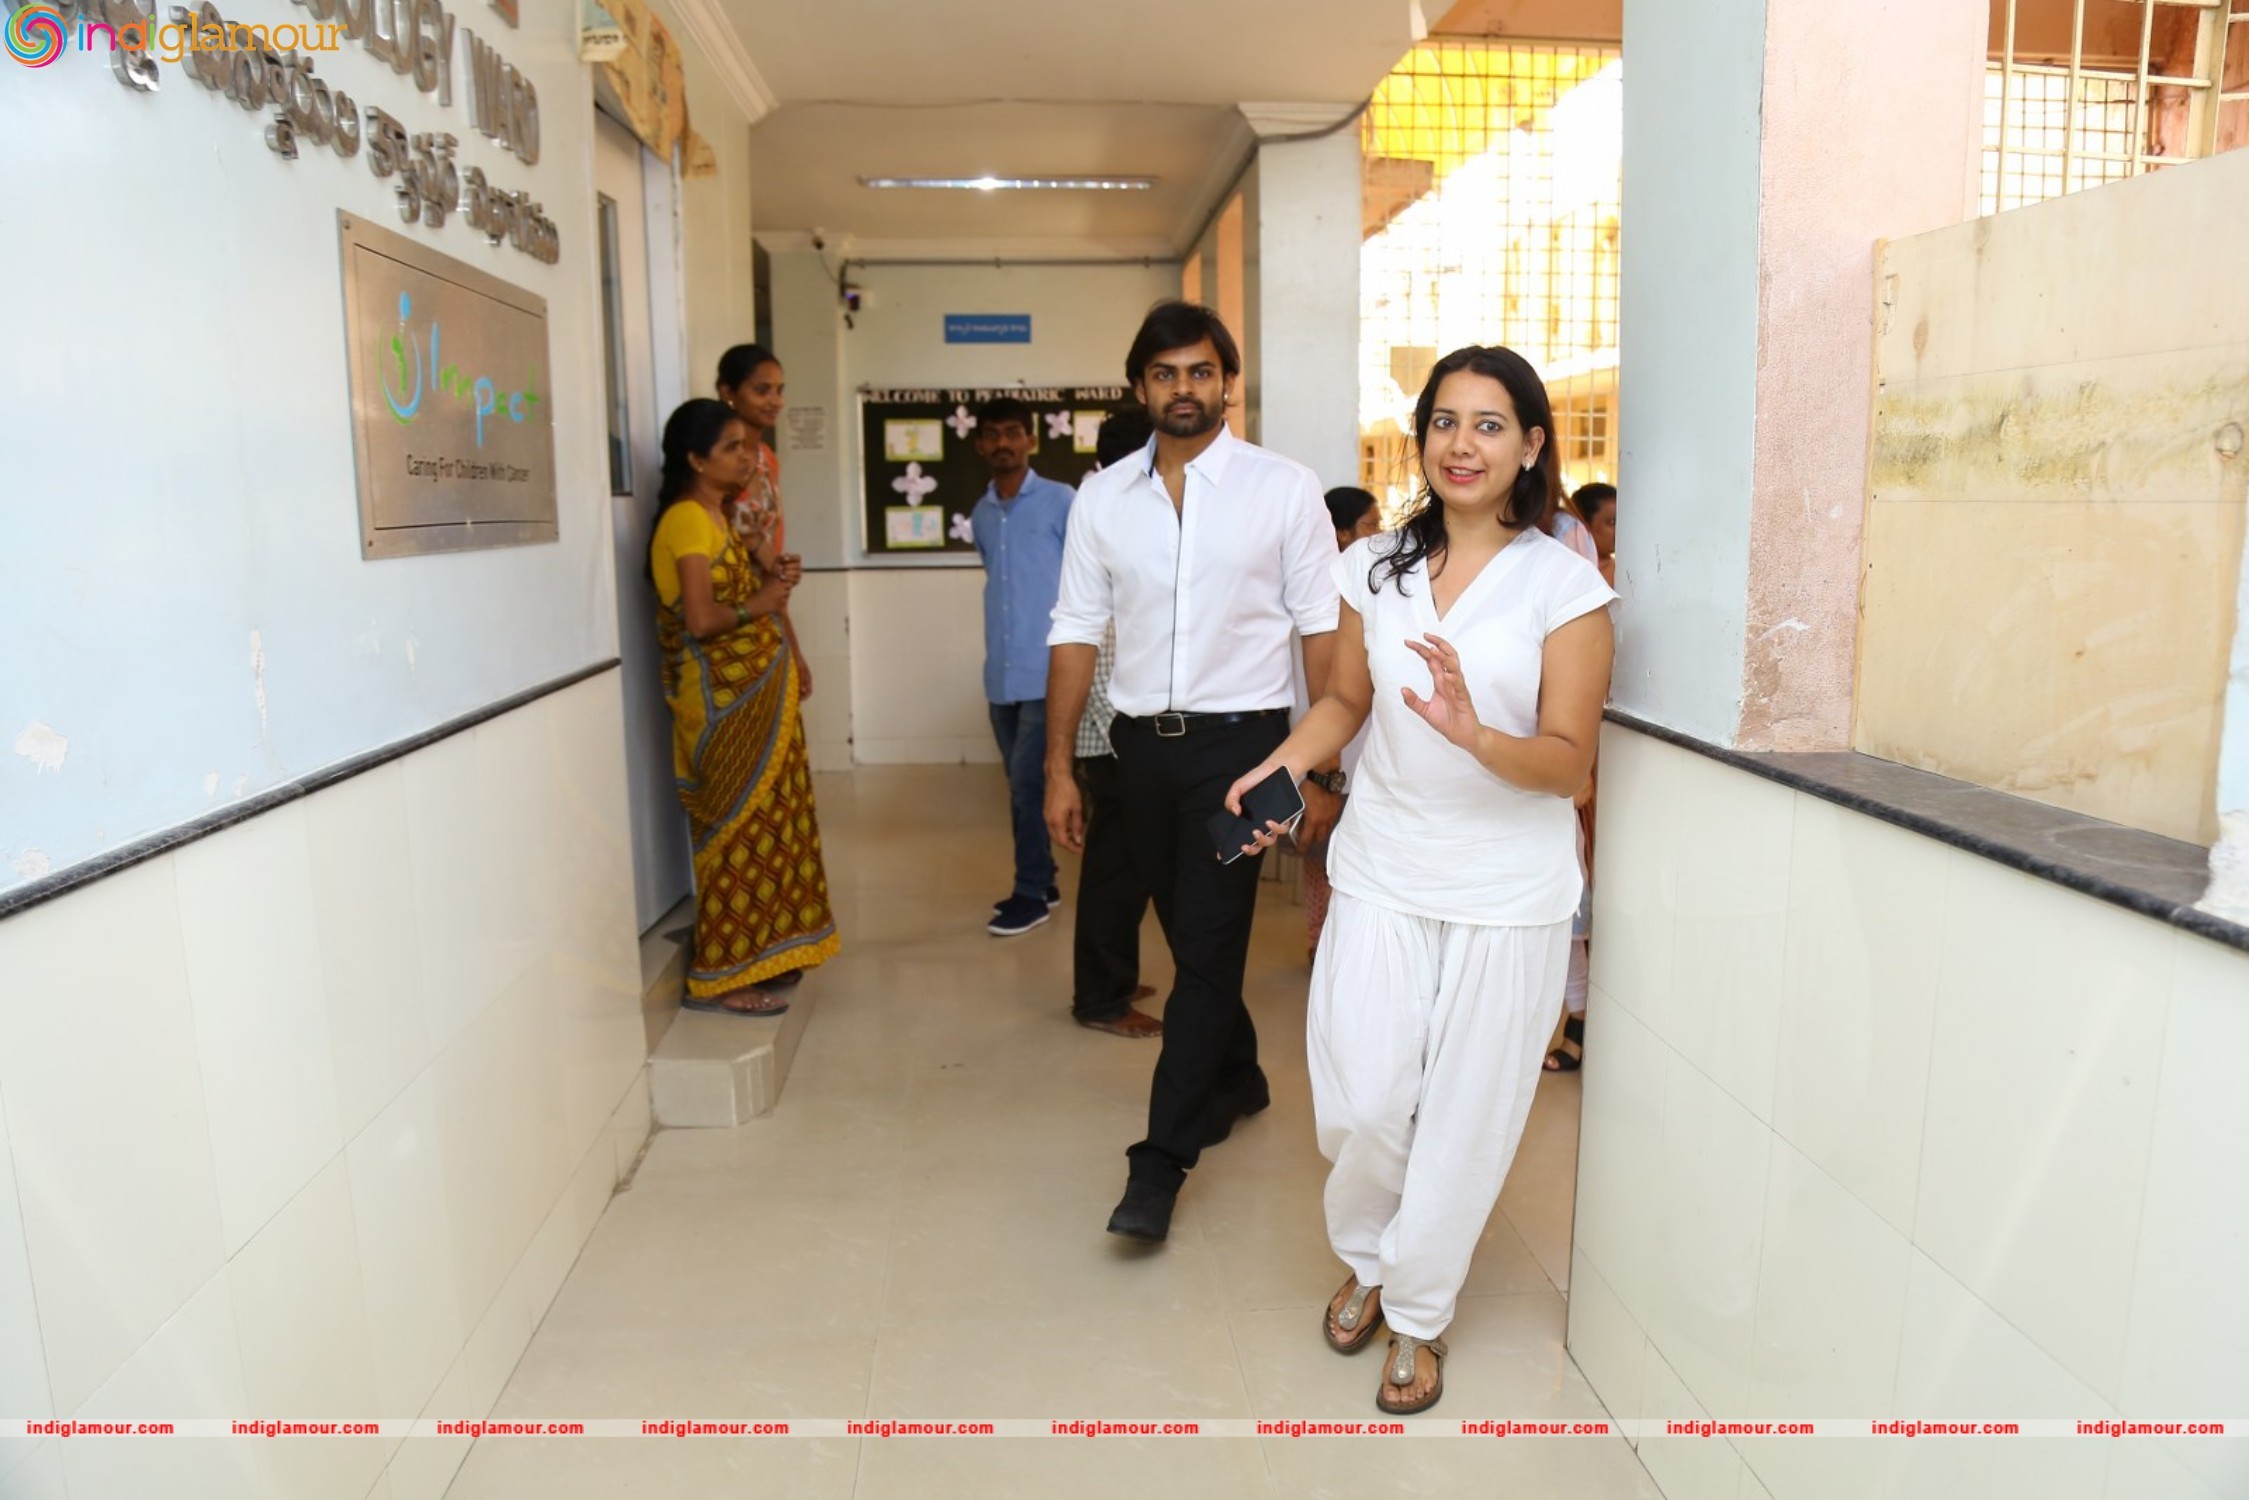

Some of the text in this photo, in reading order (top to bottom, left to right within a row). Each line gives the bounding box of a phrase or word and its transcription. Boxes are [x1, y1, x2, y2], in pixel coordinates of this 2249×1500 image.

[430, 321, 540, 448] Impact
[949, 388, 970, 404] TO
[407, 454, 438, 482] Caring
[439, 457, 454, 478] For
[455, 459, 488, 480] Children
